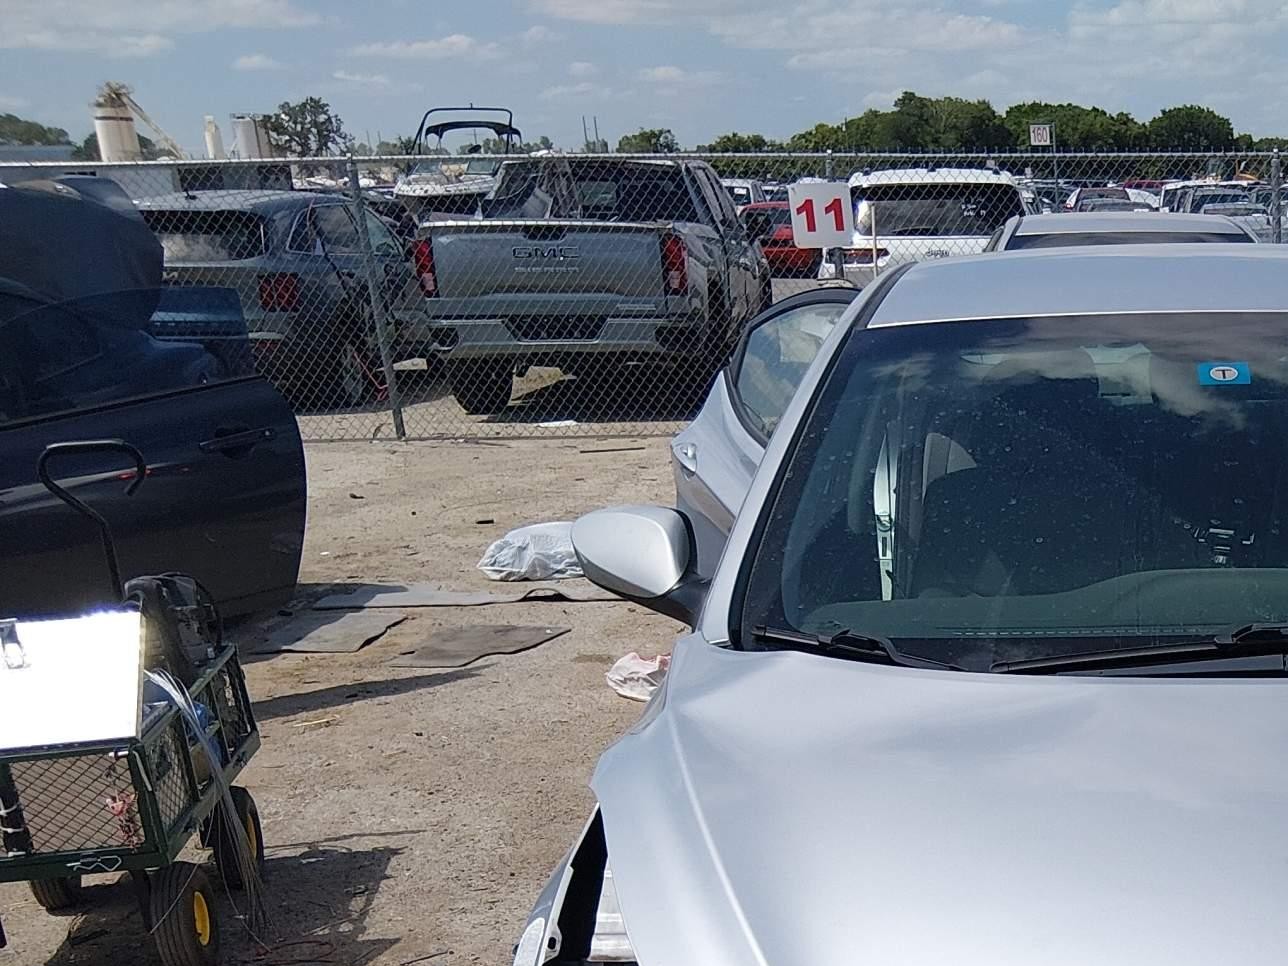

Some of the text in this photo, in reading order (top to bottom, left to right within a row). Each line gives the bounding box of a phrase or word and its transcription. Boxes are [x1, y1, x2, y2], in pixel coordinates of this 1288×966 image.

[796, 198, 845, 232] 11
[512, 246, 580, 259] GMC
[1215, 369, 1233, 379] T
